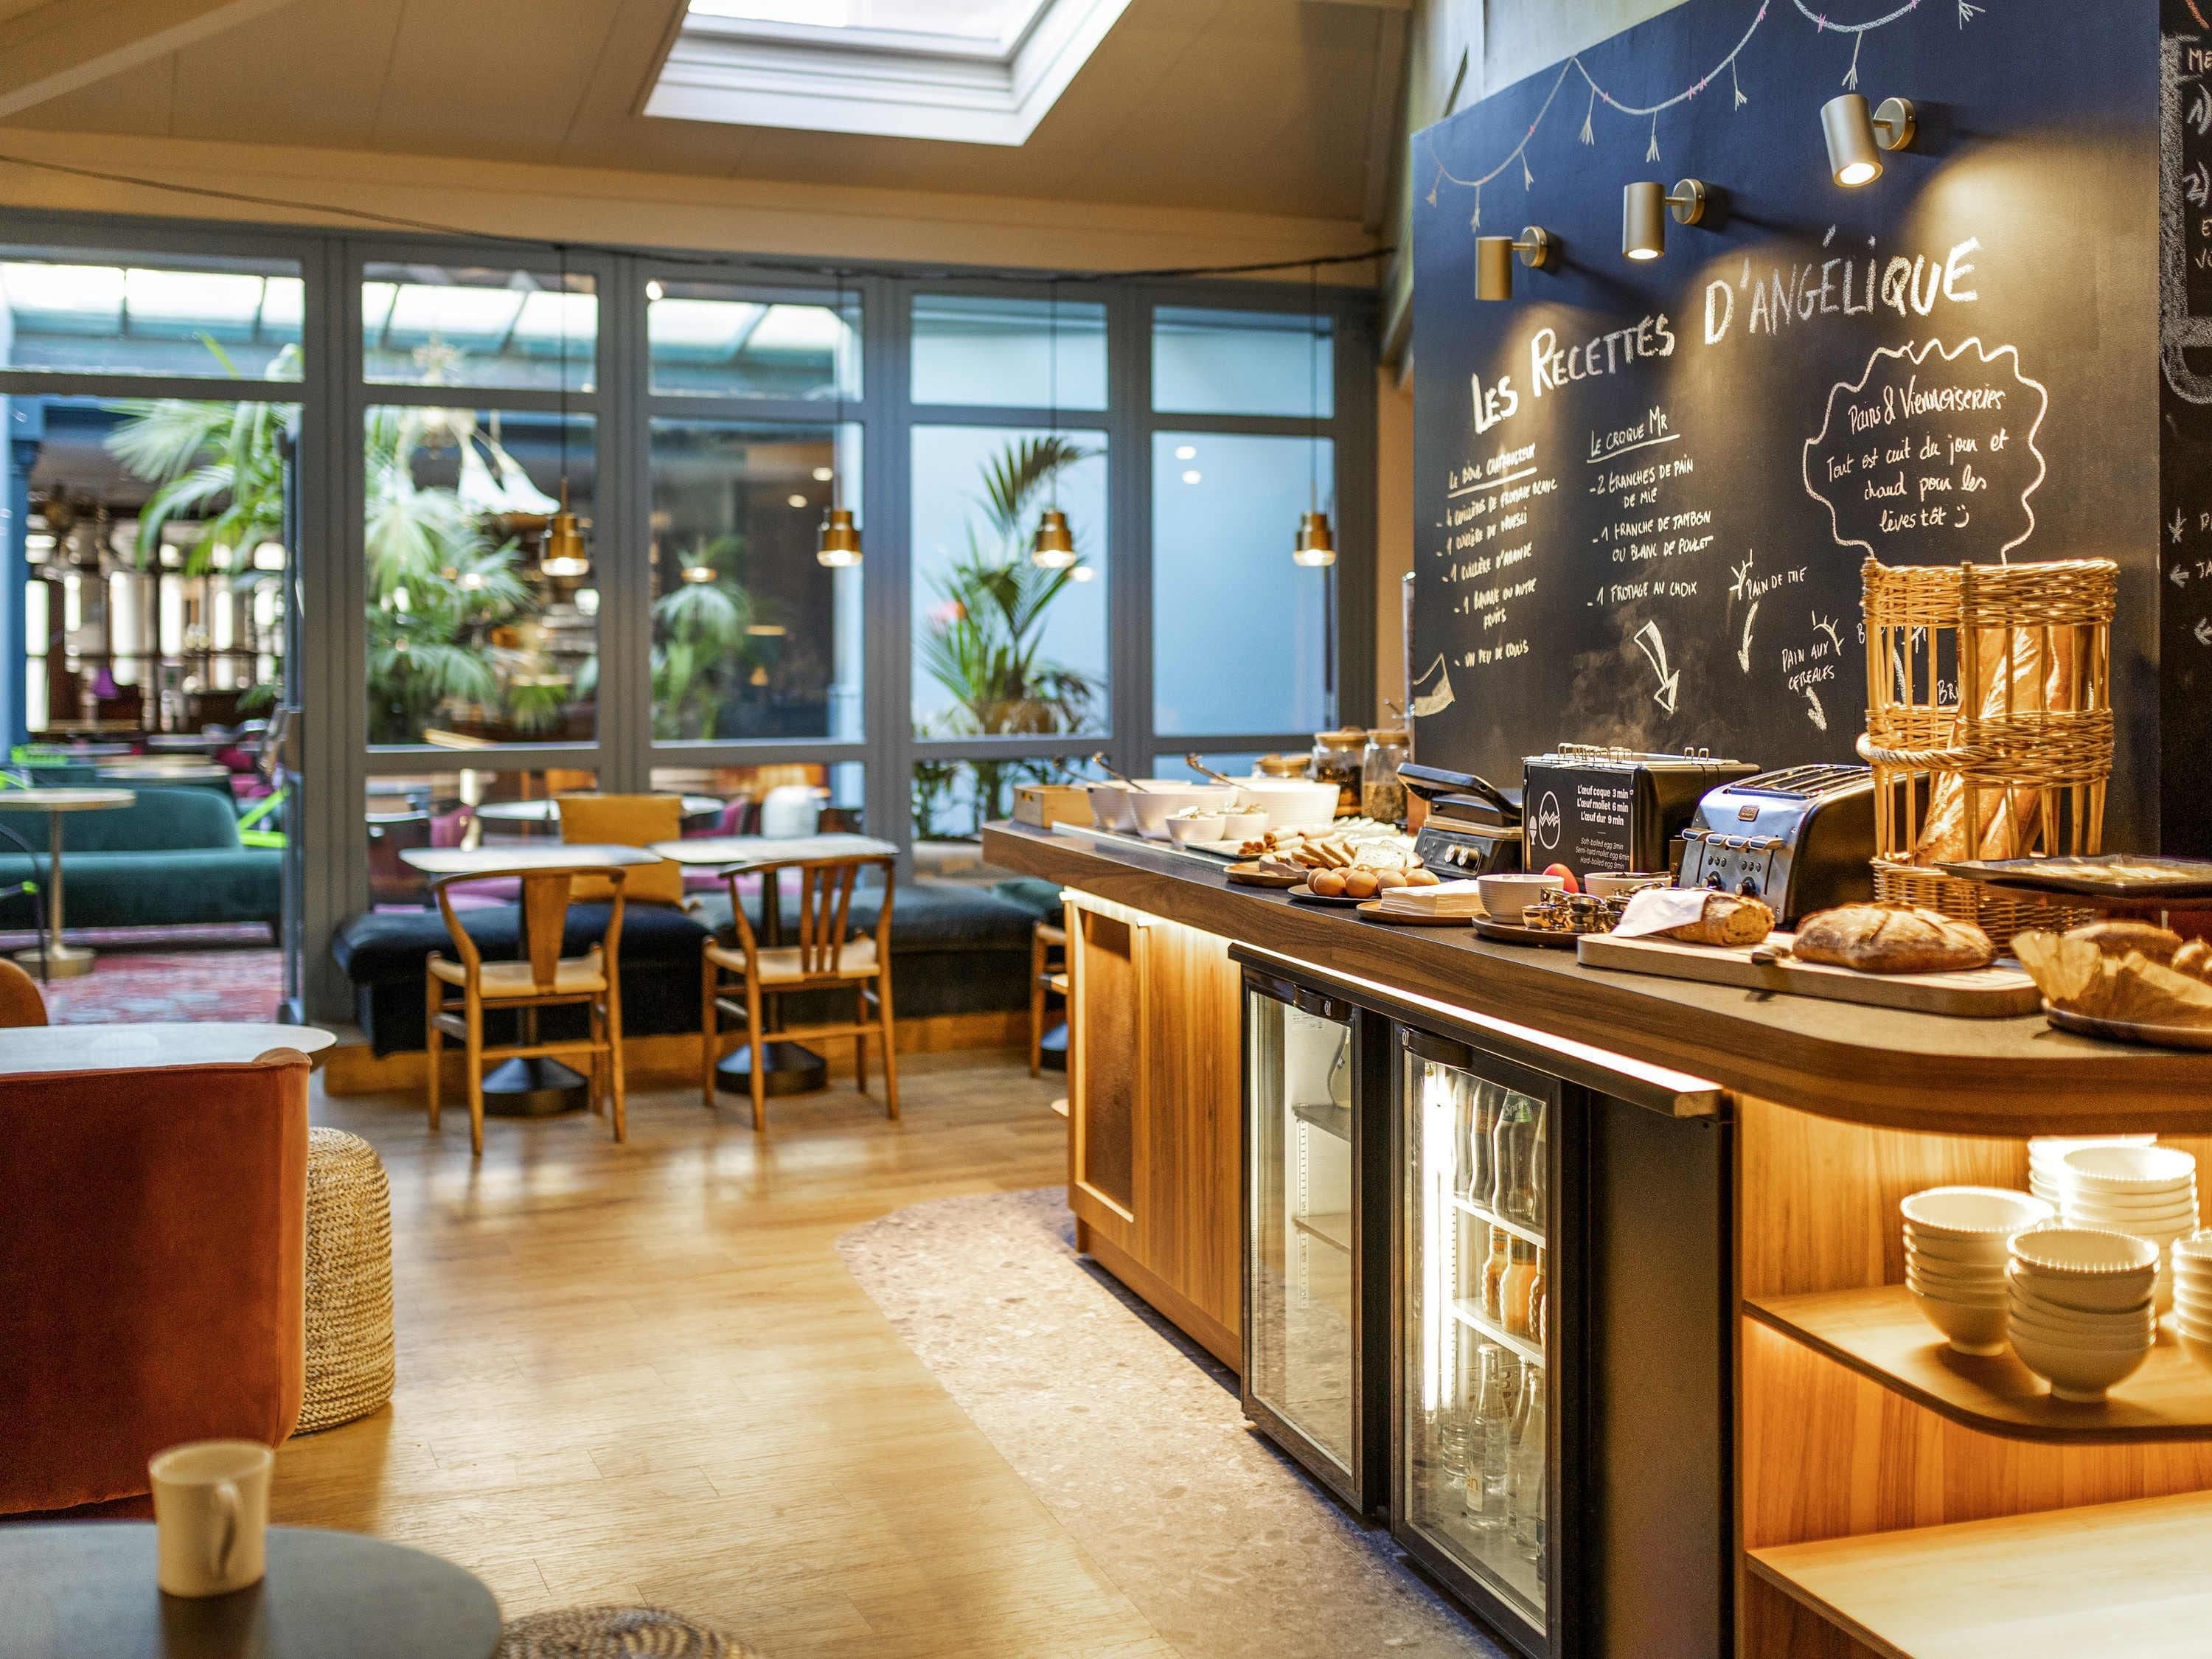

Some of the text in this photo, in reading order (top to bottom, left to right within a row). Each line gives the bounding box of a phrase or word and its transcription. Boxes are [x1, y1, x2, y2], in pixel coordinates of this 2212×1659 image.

[1531, 313, 1675, 397] RECETTES
[1606, 422, 1645, 451] CROQUE
[1862, 448, 1878, 468] est
[1885, 437, 1911, 464] cuit
[1919, 435, 1941, 459] du
[1990, 428, 2009, 451] et
[1659, 462, 1672, 479] DE
[1864, 465, 1987, 502] chaud pour les
[1624, 493, 1635, 509] DE
[1658, 515, 1670, 532] DE
[1612, 547, 1627, 563] OU
[1630, 542, 1658, 561] BLANC
[1663, 540, 1676, 557] DE
[1771, 573, 1783, 588] DE
[1811, 641, 1829, 660] AUX
[1593, 787, 1611, 799] coque
[1612, 789, 1617, 797] 3
[1617, 788, 1629, 799] min
[1593, 799, 1611, 810] mollet
[1612, 802, 1617, 811] 6
[1617, 801, 1629, 813] min
[1596, 813, 1607, 824] dur
[1608, 815, 1613, 824] 9
[1613, 815, 1624, 826] min
[1604, 842, 1613, 850] egg
[1610, 852, 1618, 860] egg
